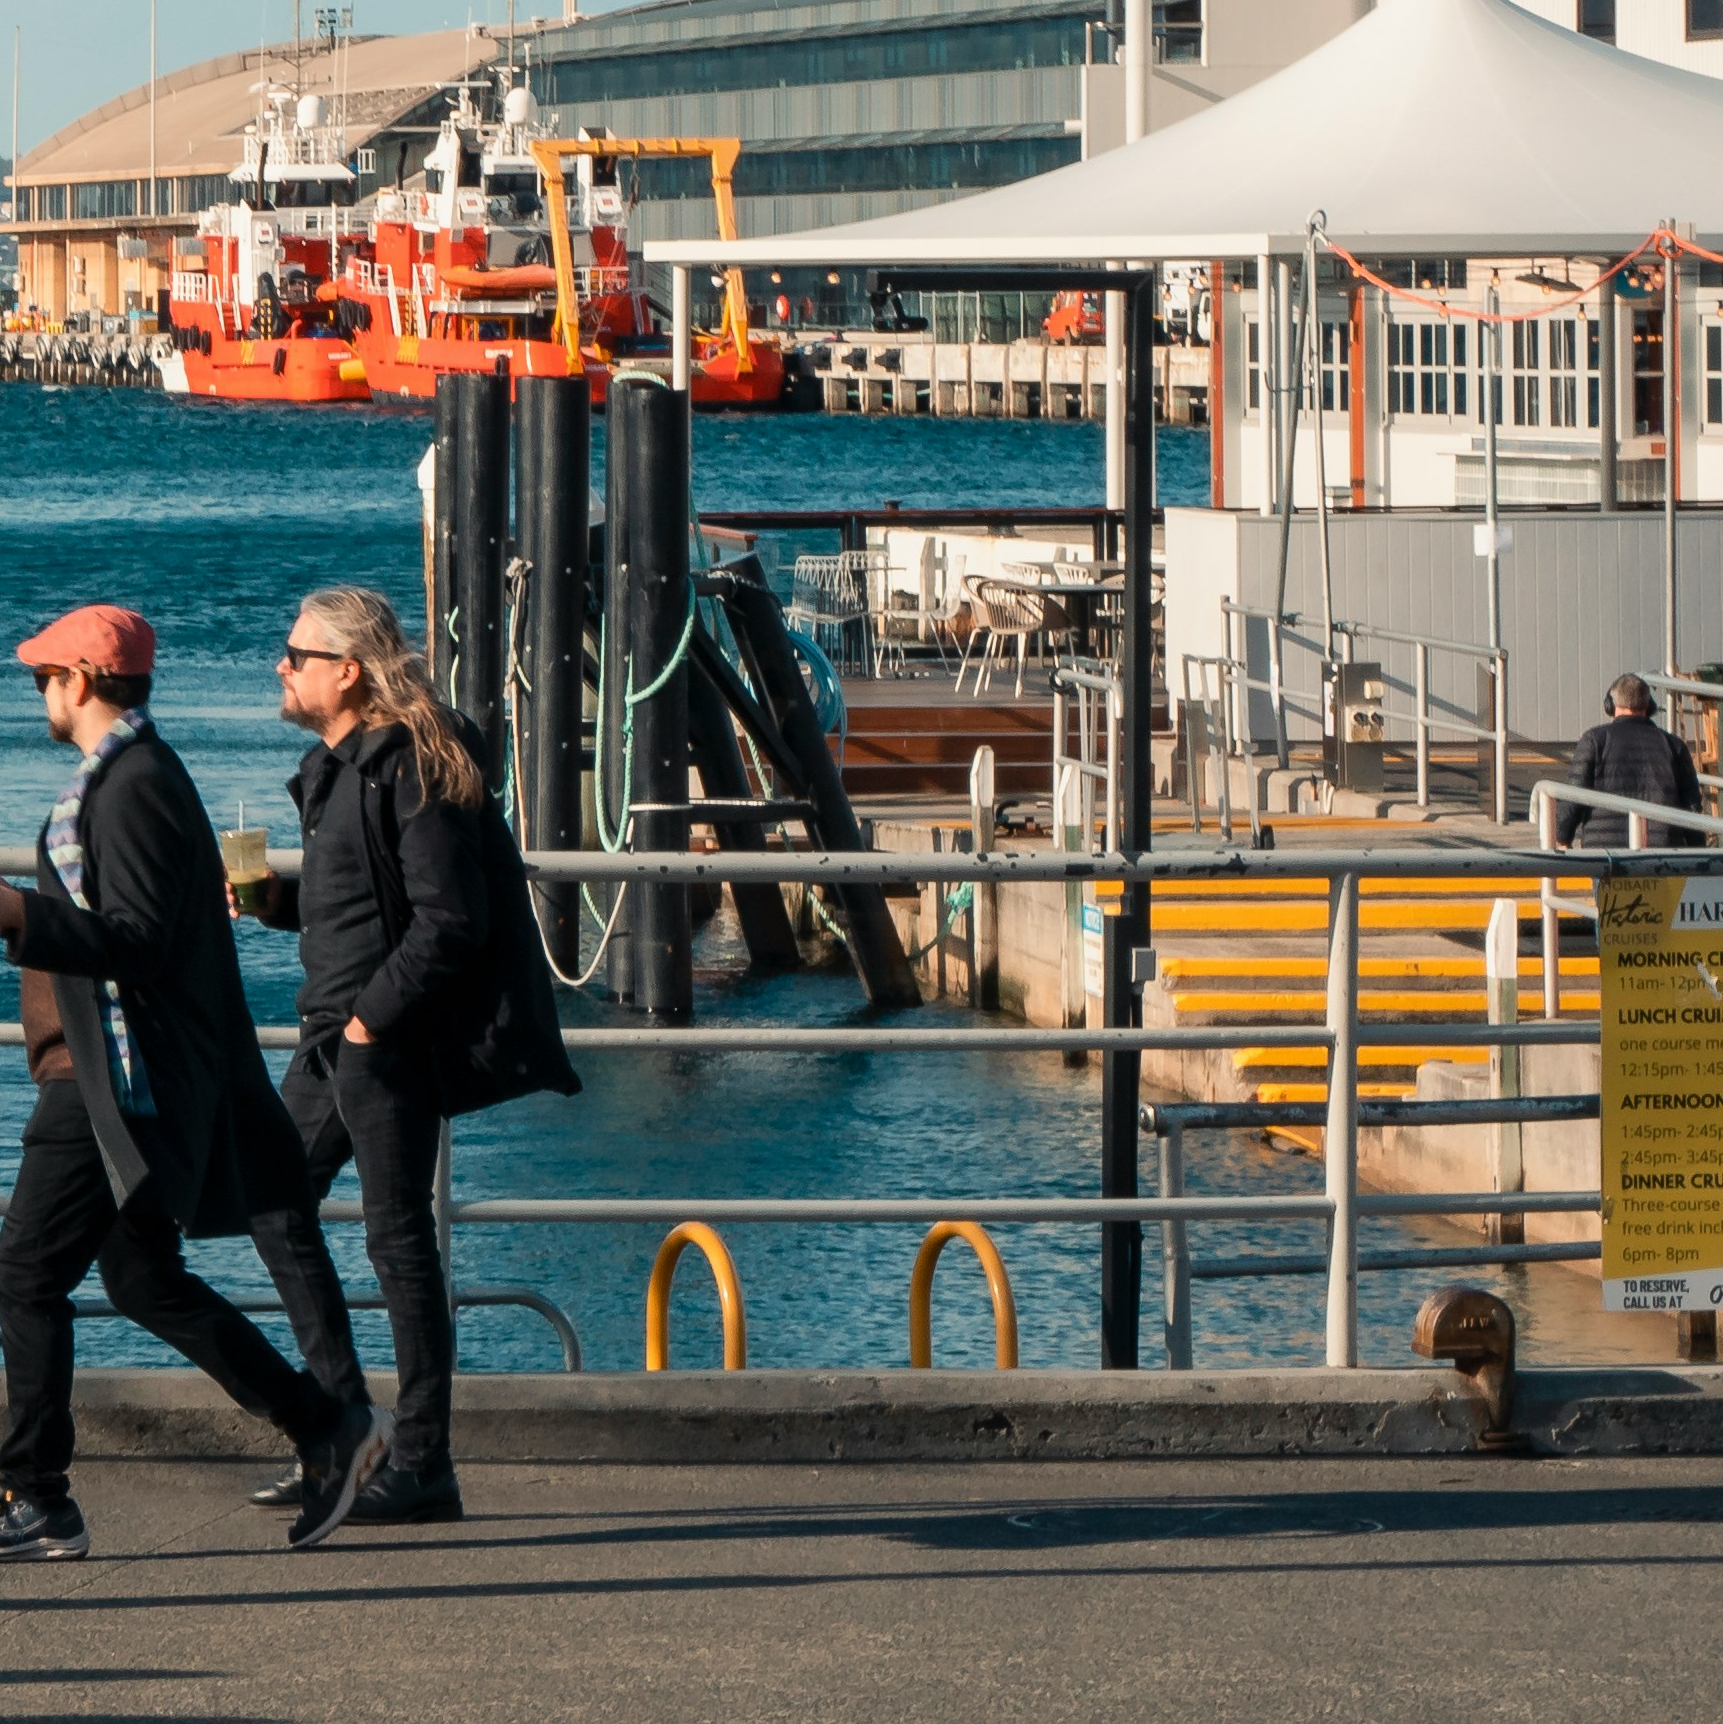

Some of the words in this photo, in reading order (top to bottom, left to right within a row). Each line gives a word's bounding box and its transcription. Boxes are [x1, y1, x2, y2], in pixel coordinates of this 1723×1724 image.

[1600, 893, 1664, 929] Historic
[1604, 932, 1659, 946] CRUISES
[1618, 951, 1703, 968] MORNING
[1619, 1009, 1676, 1024] LUNCH
[1681, 1008, 1723, 1023] CRUI
[1620, 1038, 1647, 1051] one
[1652, 1037, 1701, 1051] course
[1621, 1093, 1723, 1110] AFTERNOON
[1621, 1174, 1685, 1190] DINNER
[1622, 1198, 1720, 1212] Three-course
[1622, 1221, 1651, 1235] free
[1656, 1220, 1695, 1235] drink
[1666, 1247, 1699, 1264] 8pm
[1623, 1280, 1637, 1293] TO
[1640, 1279, 1689, 1294] RESERVE,
[1623, 1296, 1651, 1309] CALL
[1652, 1296, 1666, 1309] US
[1669, 1295, 1683, 1308] AT
